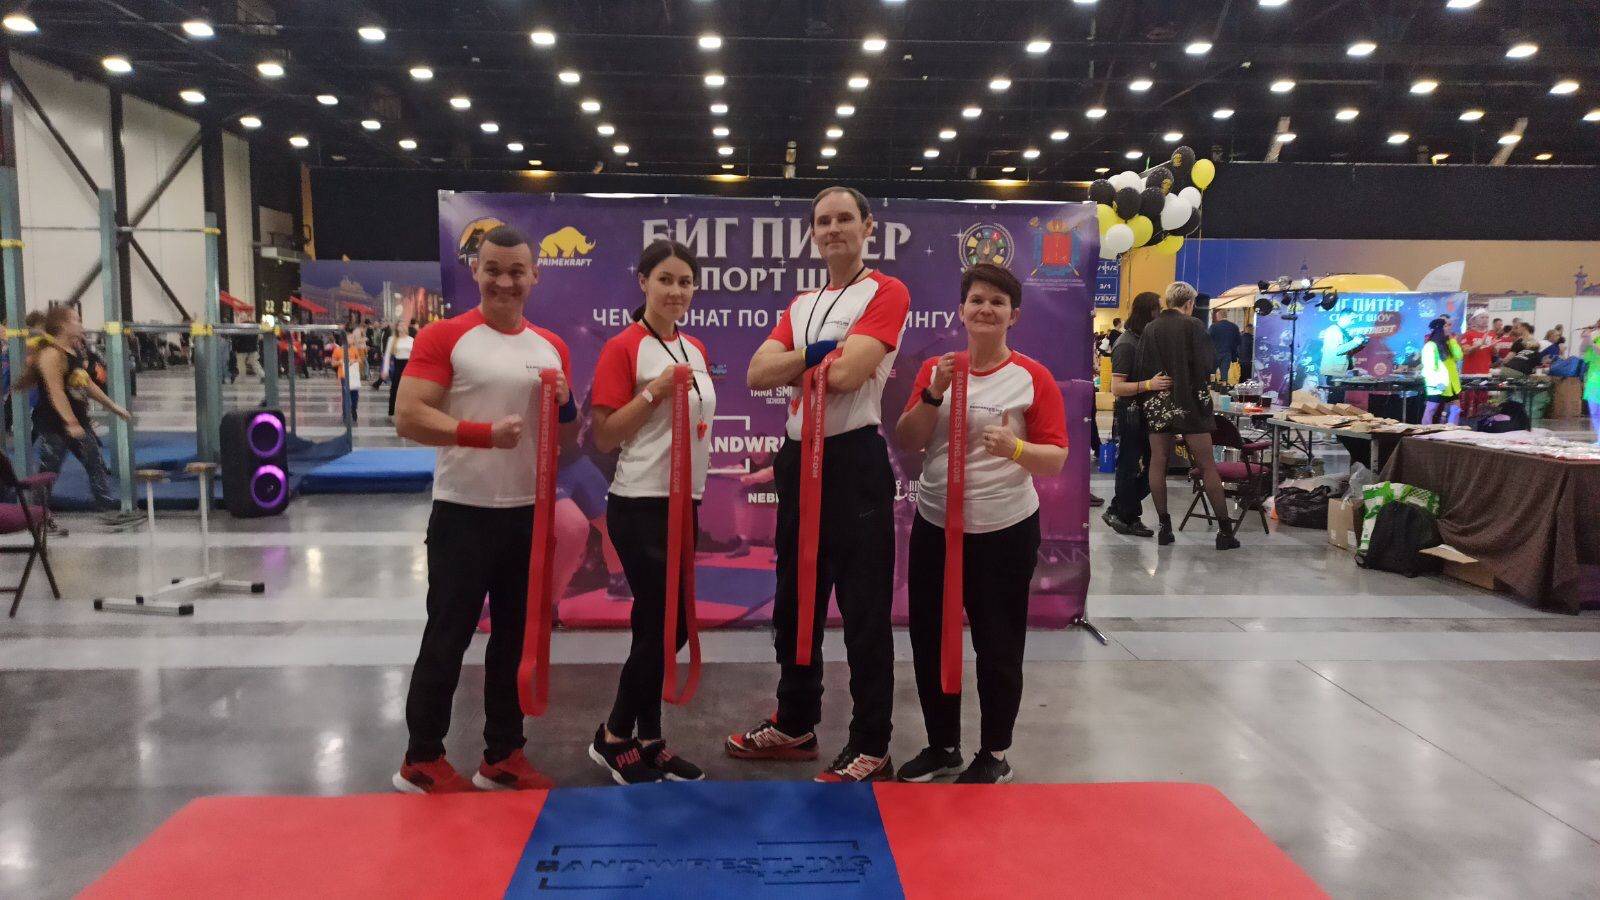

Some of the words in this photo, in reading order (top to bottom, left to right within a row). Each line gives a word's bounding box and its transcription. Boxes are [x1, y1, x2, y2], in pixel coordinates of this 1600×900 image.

[752, 217, 912, 260] ПИЕР
[537, 258, 592, 267] PRIMEKRAFT
[693, 266, 787, 292] ПОРТ
[593, 308, 732, 327] ЧЕМОНАТ
[739, 309, 769, 328] ПО
